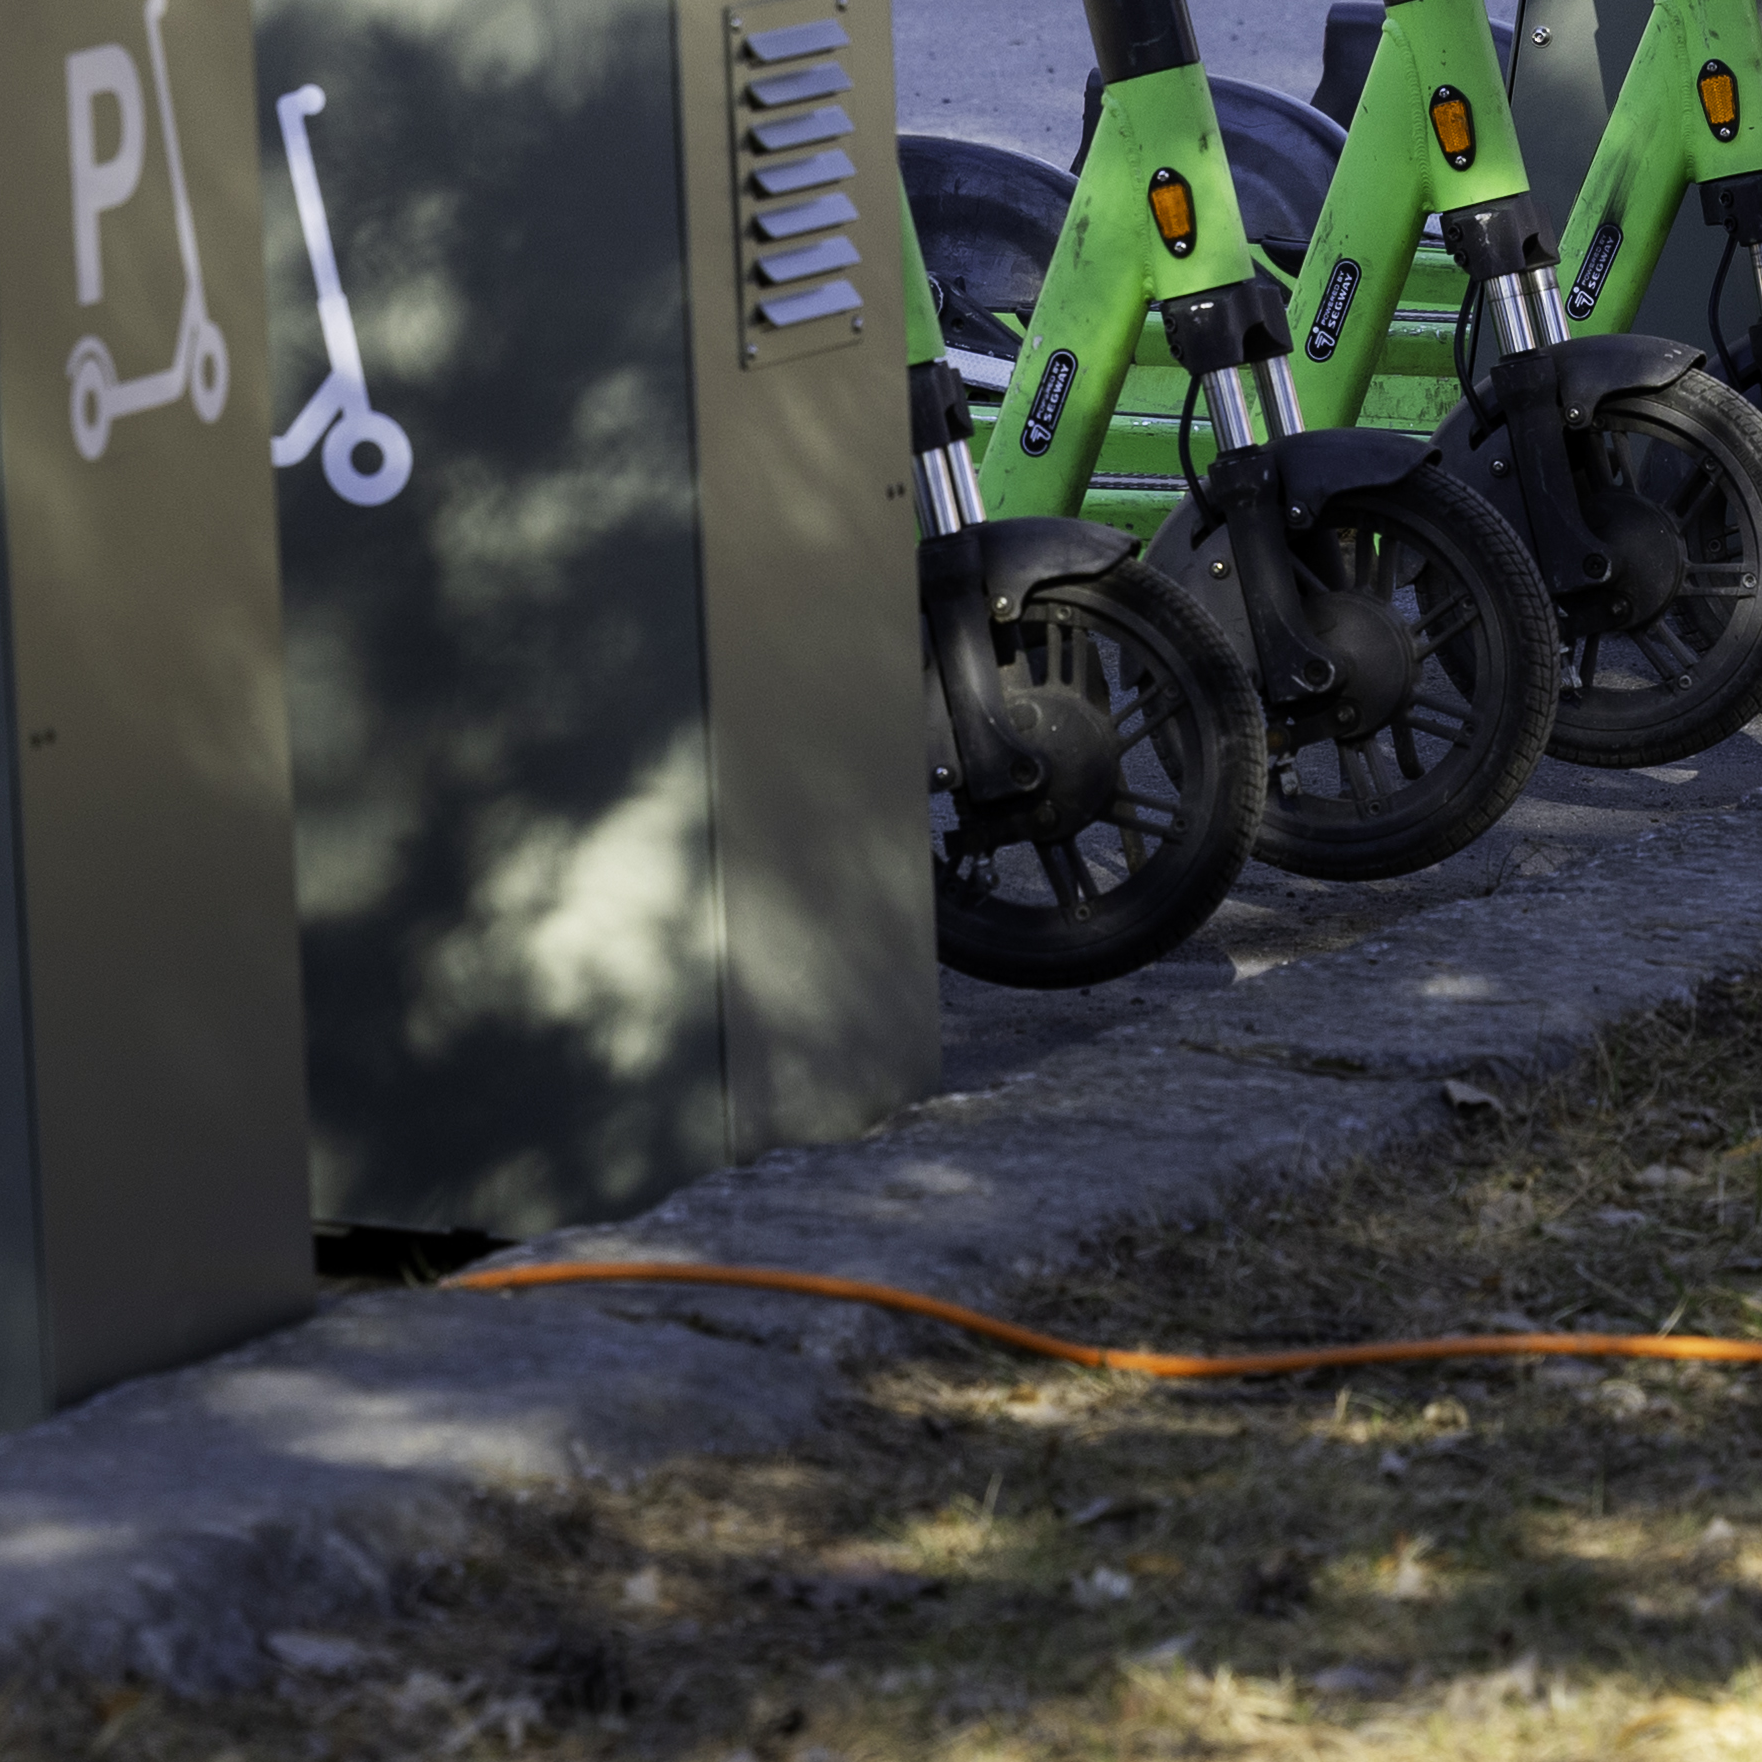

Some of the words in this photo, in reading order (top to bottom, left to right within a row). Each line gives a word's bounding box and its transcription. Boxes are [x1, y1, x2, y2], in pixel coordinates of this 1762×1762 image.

[66, 43, 146, 307] P
[1581, 245, 1602, 287] POWERED
[1599, 233, 1608, 245] BY
[1587, 237, 1614, 289] SEGWAY
[1320, 284, 1341, 326] POWERED
[1336, 270, 1345, 283] BY
[1328, 272, 1352, 330] SEGWAY
[1036, 375, 1056, 420] POWERED
[1052, 360, 1061, 374] BY
[1043, 363, 1069, 423] SEGWAY
